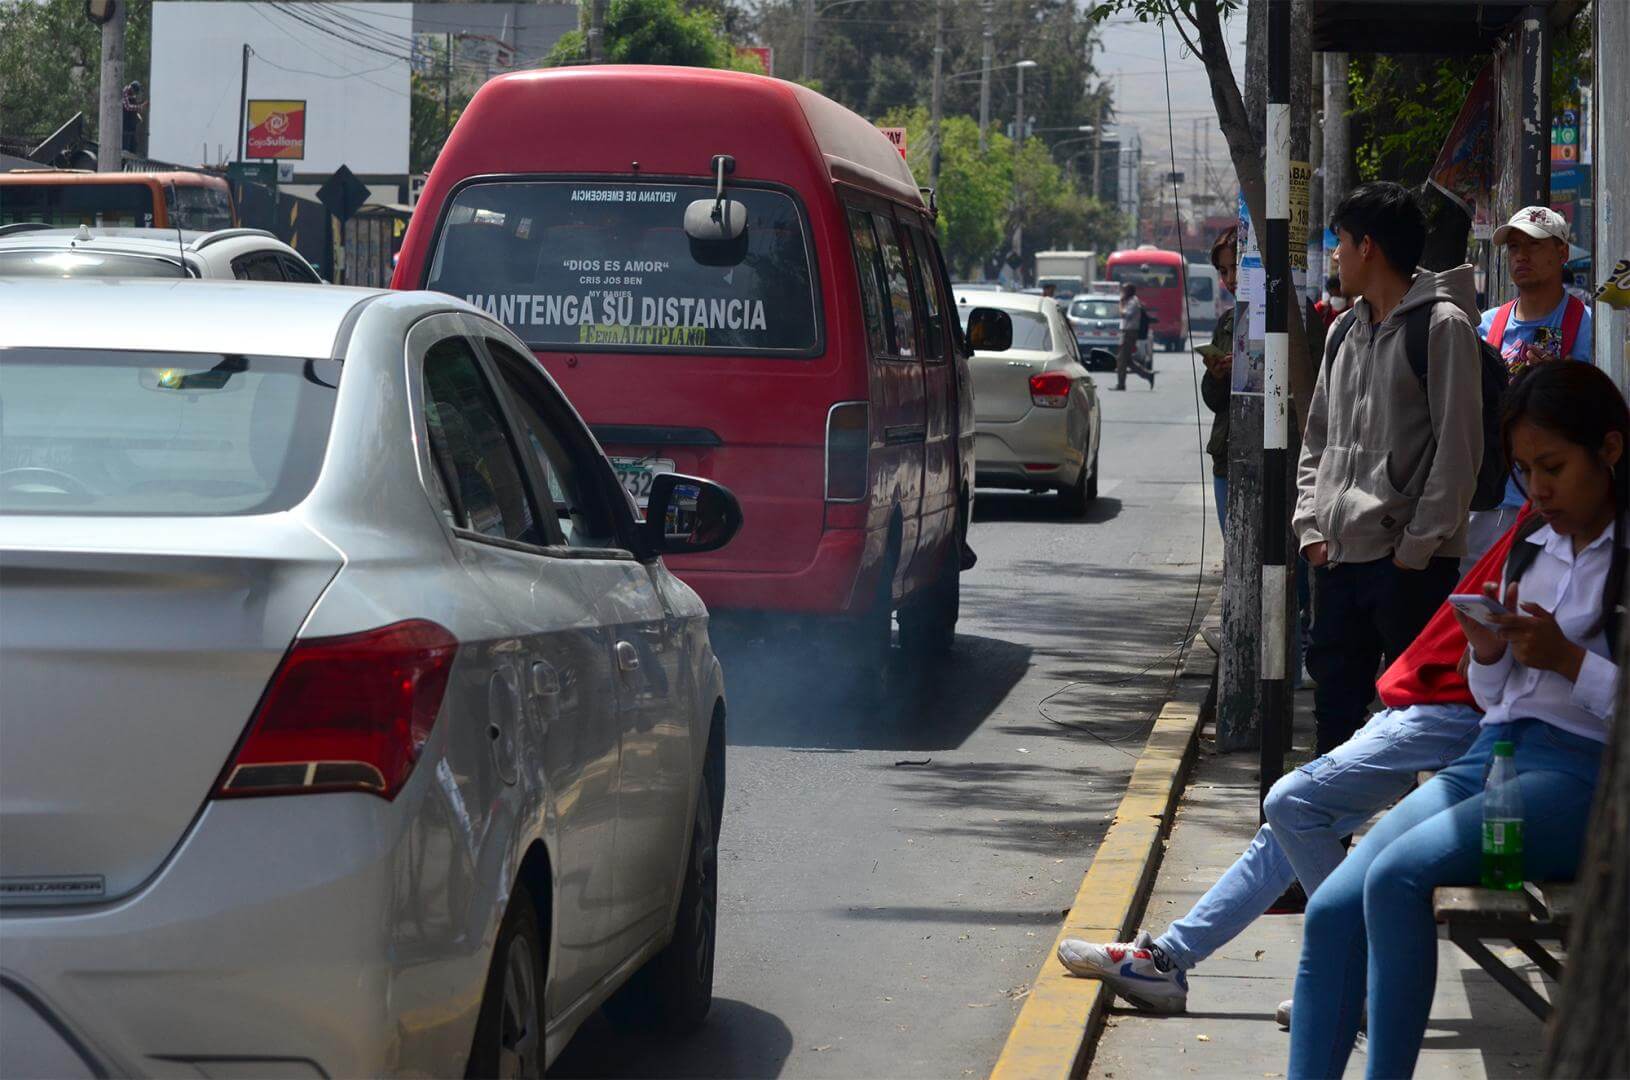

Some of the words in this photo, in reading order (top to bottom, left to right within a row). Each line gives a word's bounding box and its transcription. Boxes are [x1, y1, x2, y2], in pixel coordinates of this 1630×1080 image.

[604, 260, 620, 271] ES
[580, 276, 601, 285] CRIS
[603, 277, 621, 285] JOS
[623, 277, 642, 285] BEN
[601, 295, 633, 326] SU
[641, 296, 767, 330] DISTANCIA
